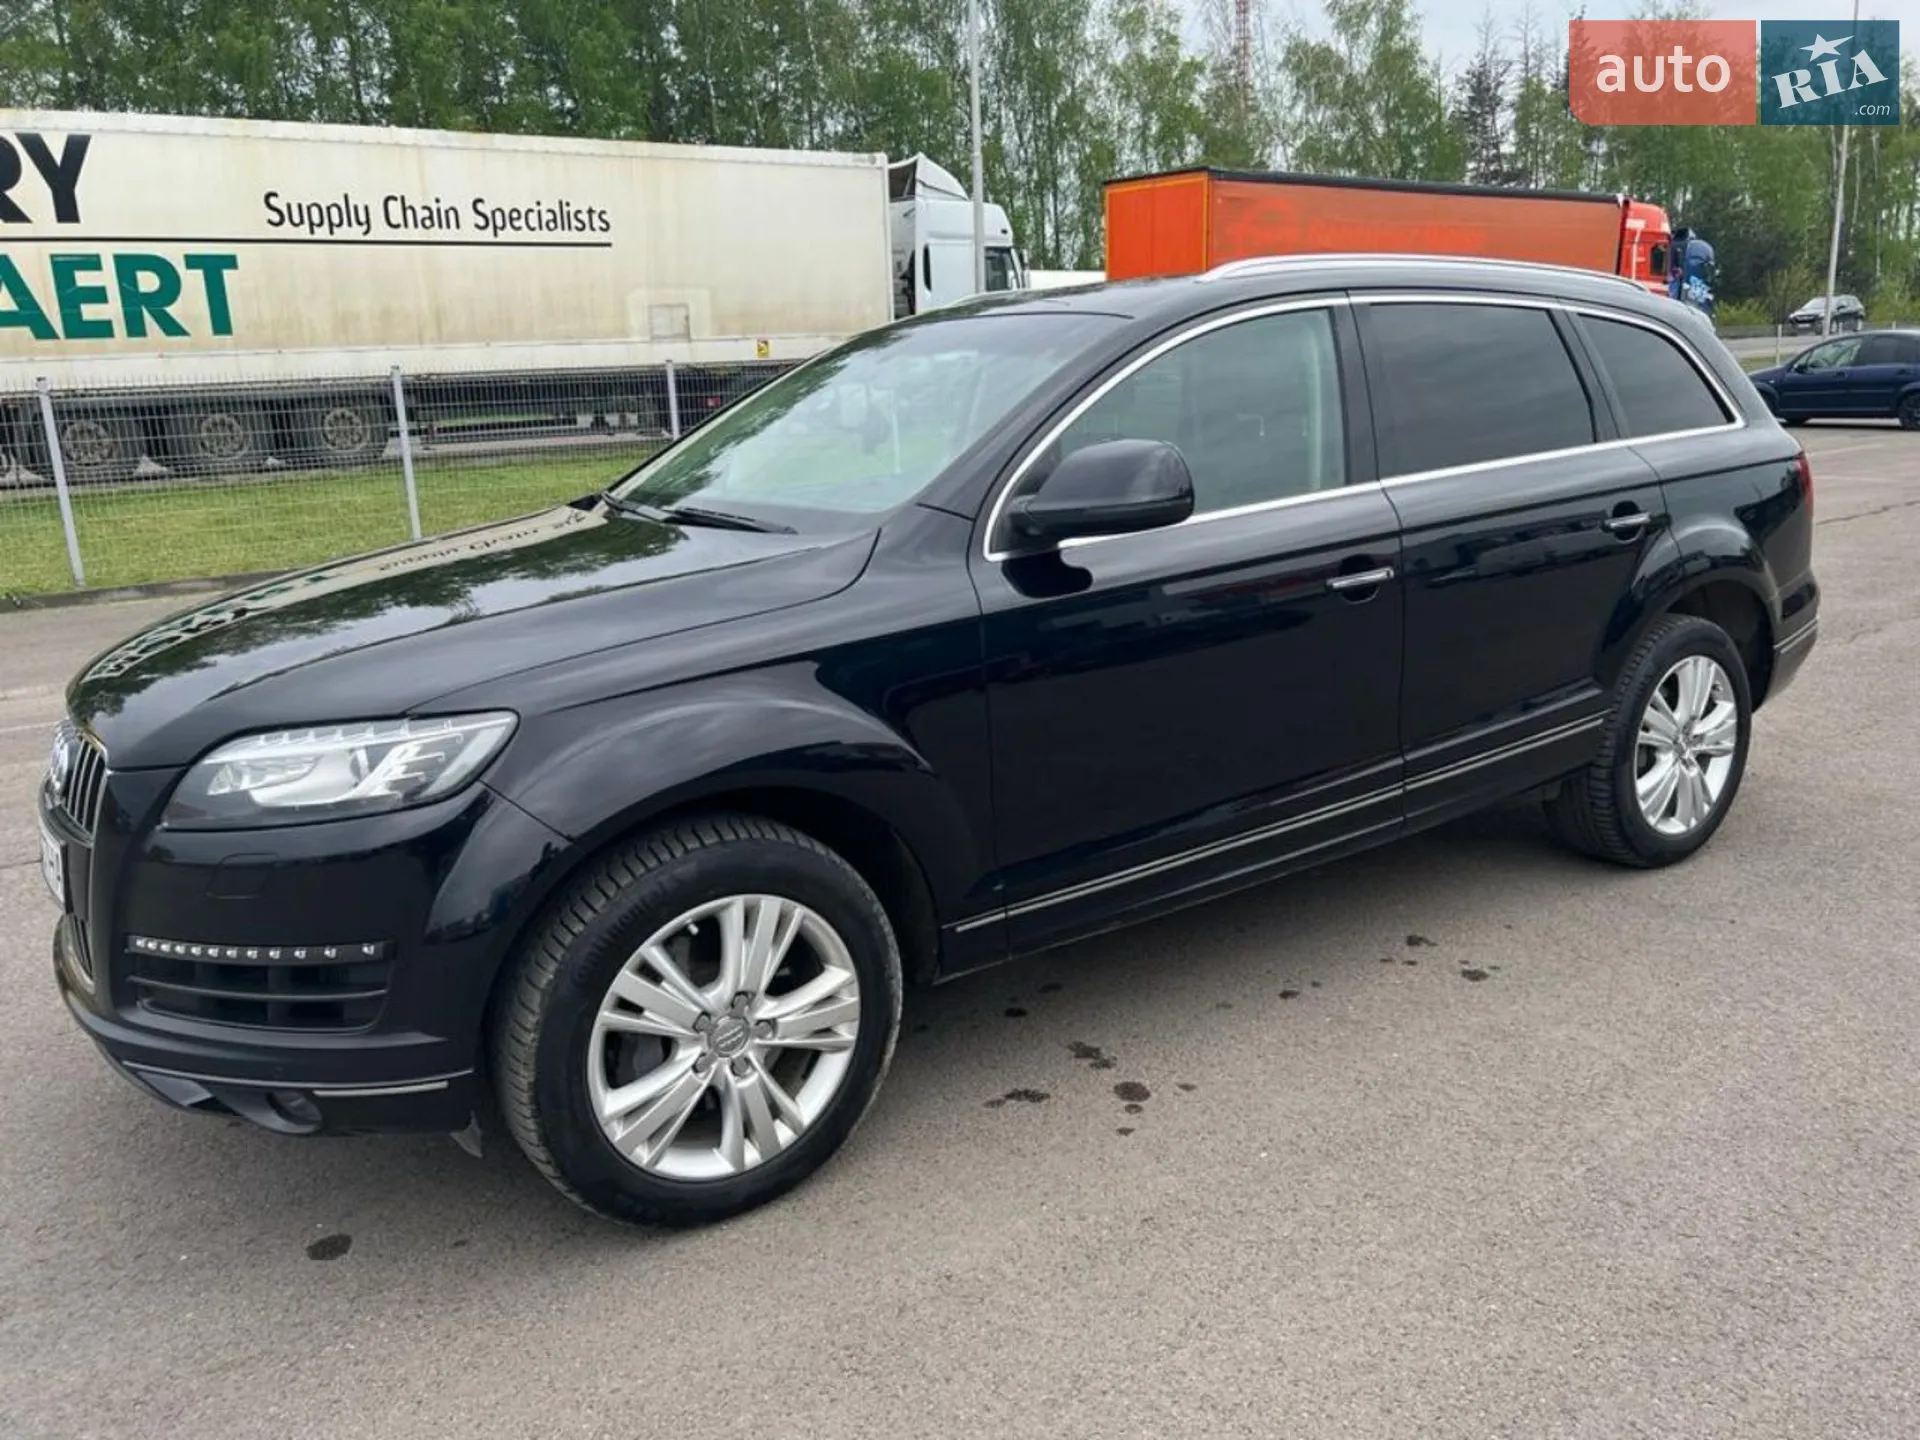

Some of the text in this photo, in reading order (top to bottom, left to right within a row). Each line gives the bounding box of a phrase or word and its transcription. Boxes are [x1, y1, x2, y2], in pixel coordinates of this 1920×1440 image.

[264, 191, 611, 238] Supply Chain Specialists
[0, 253, 239, 340] AERT
